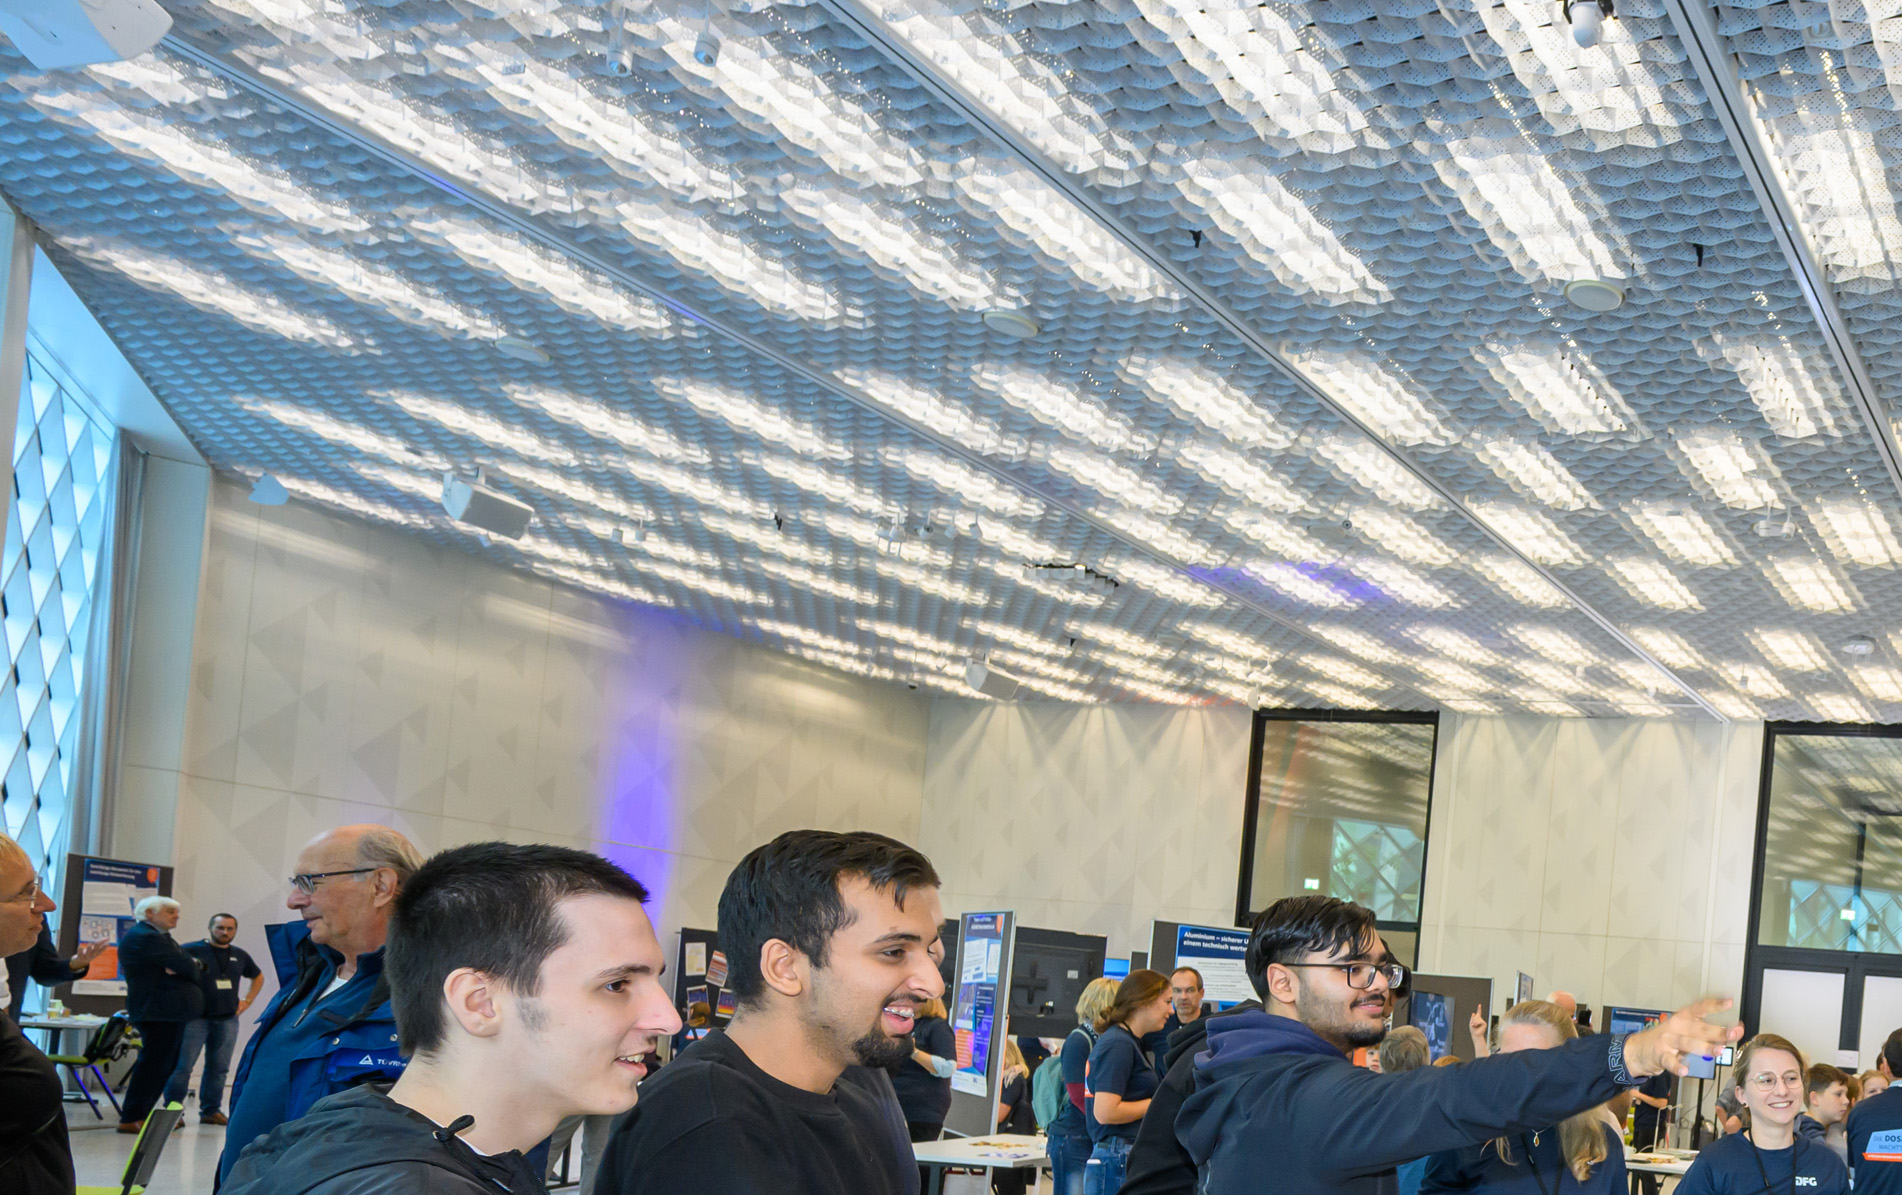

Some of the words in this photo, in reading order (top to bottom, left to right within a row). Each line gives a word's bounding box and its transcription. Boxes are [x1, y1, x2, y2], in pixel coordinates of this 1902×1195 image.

[1184, 931, 1215, 940] Aluminium
[1221, 936, 1243, 944] sicherer
[1183, 939, 1201, 947] einem
[1202, 941, 1229, 950] technisch
[1795, 1176, 1818, 1187] DFG
